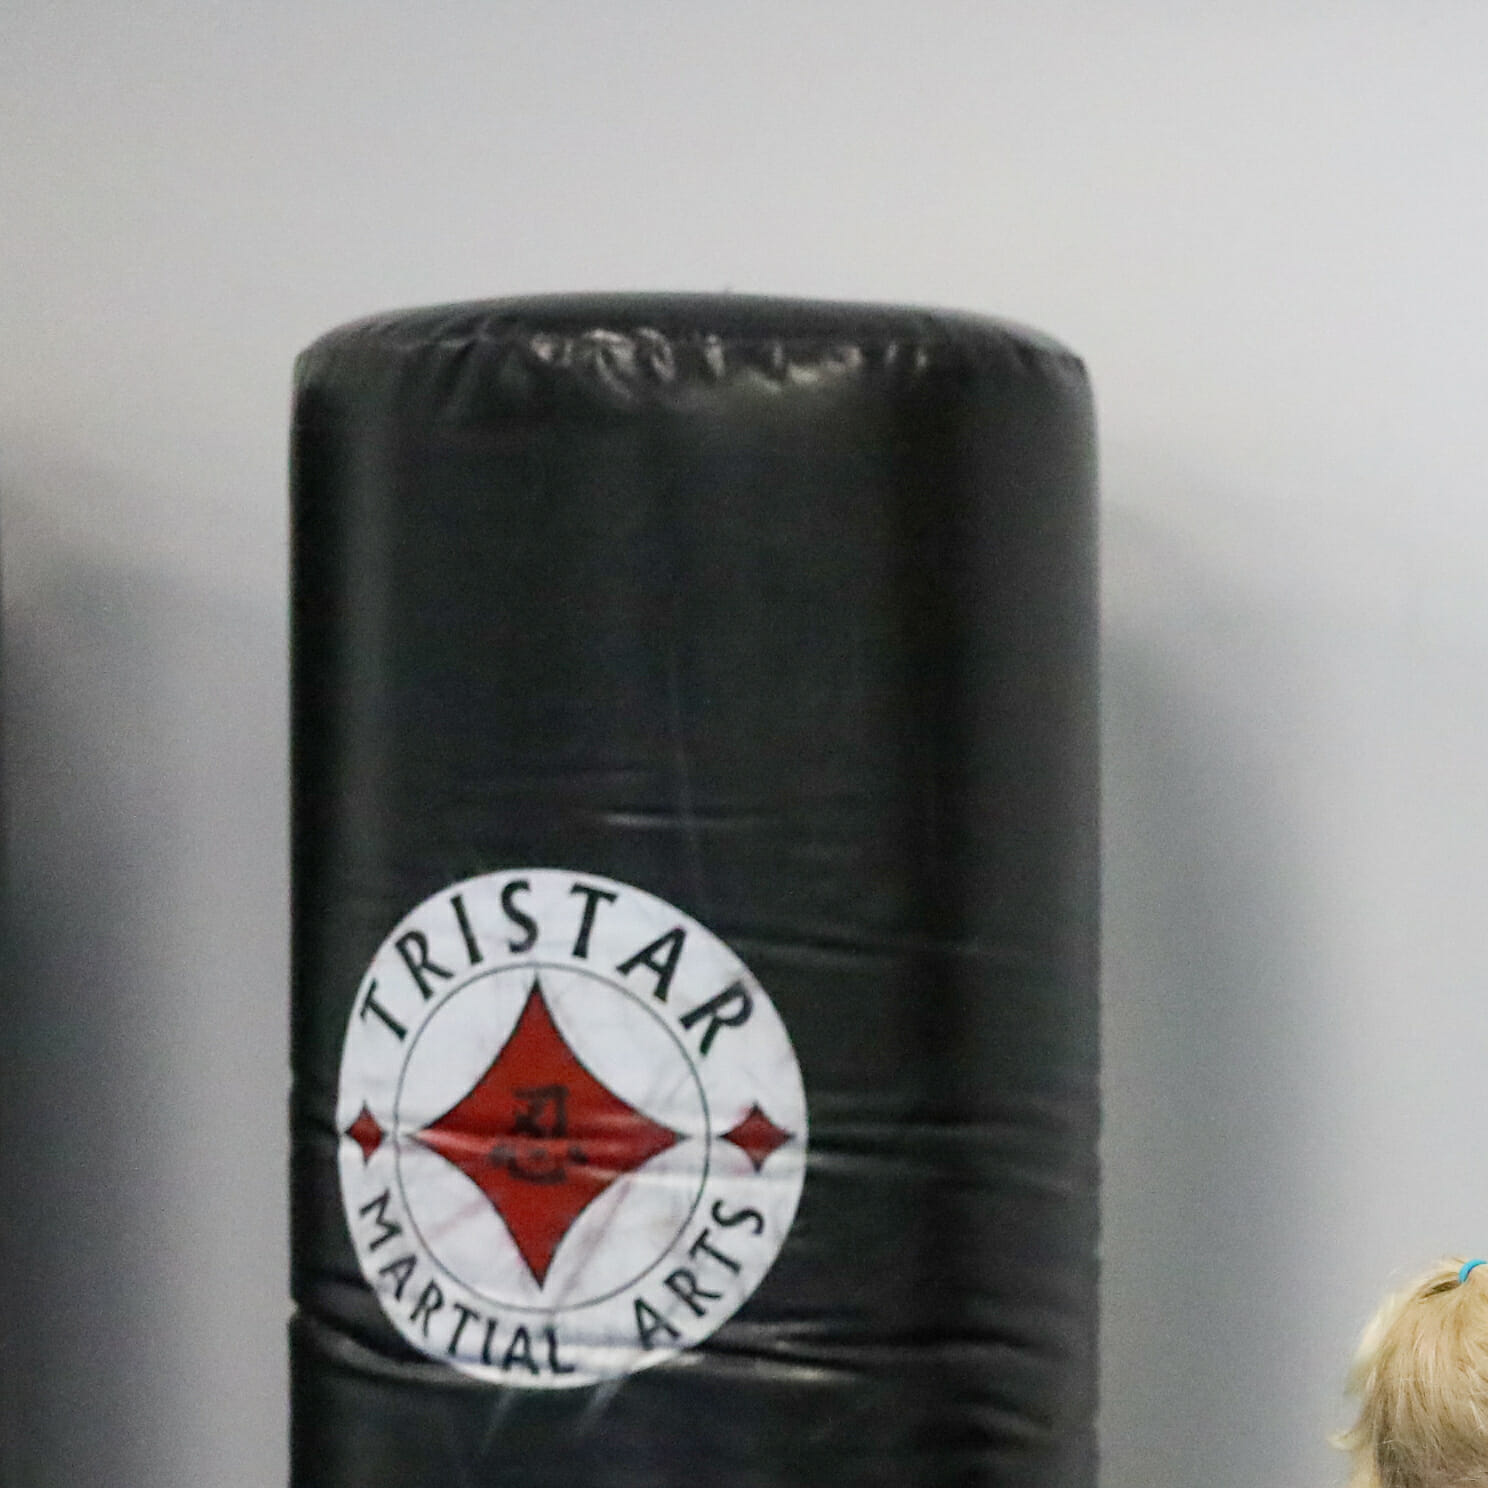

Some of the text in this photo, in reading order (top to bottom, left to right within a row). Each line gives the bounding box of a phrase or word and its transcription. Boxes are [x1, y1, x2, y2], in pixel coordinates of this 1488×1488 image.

[359, 877, 754, 1056] TRISTAR
[359, 1189, 765, 1376] MARTIAL ARTS
